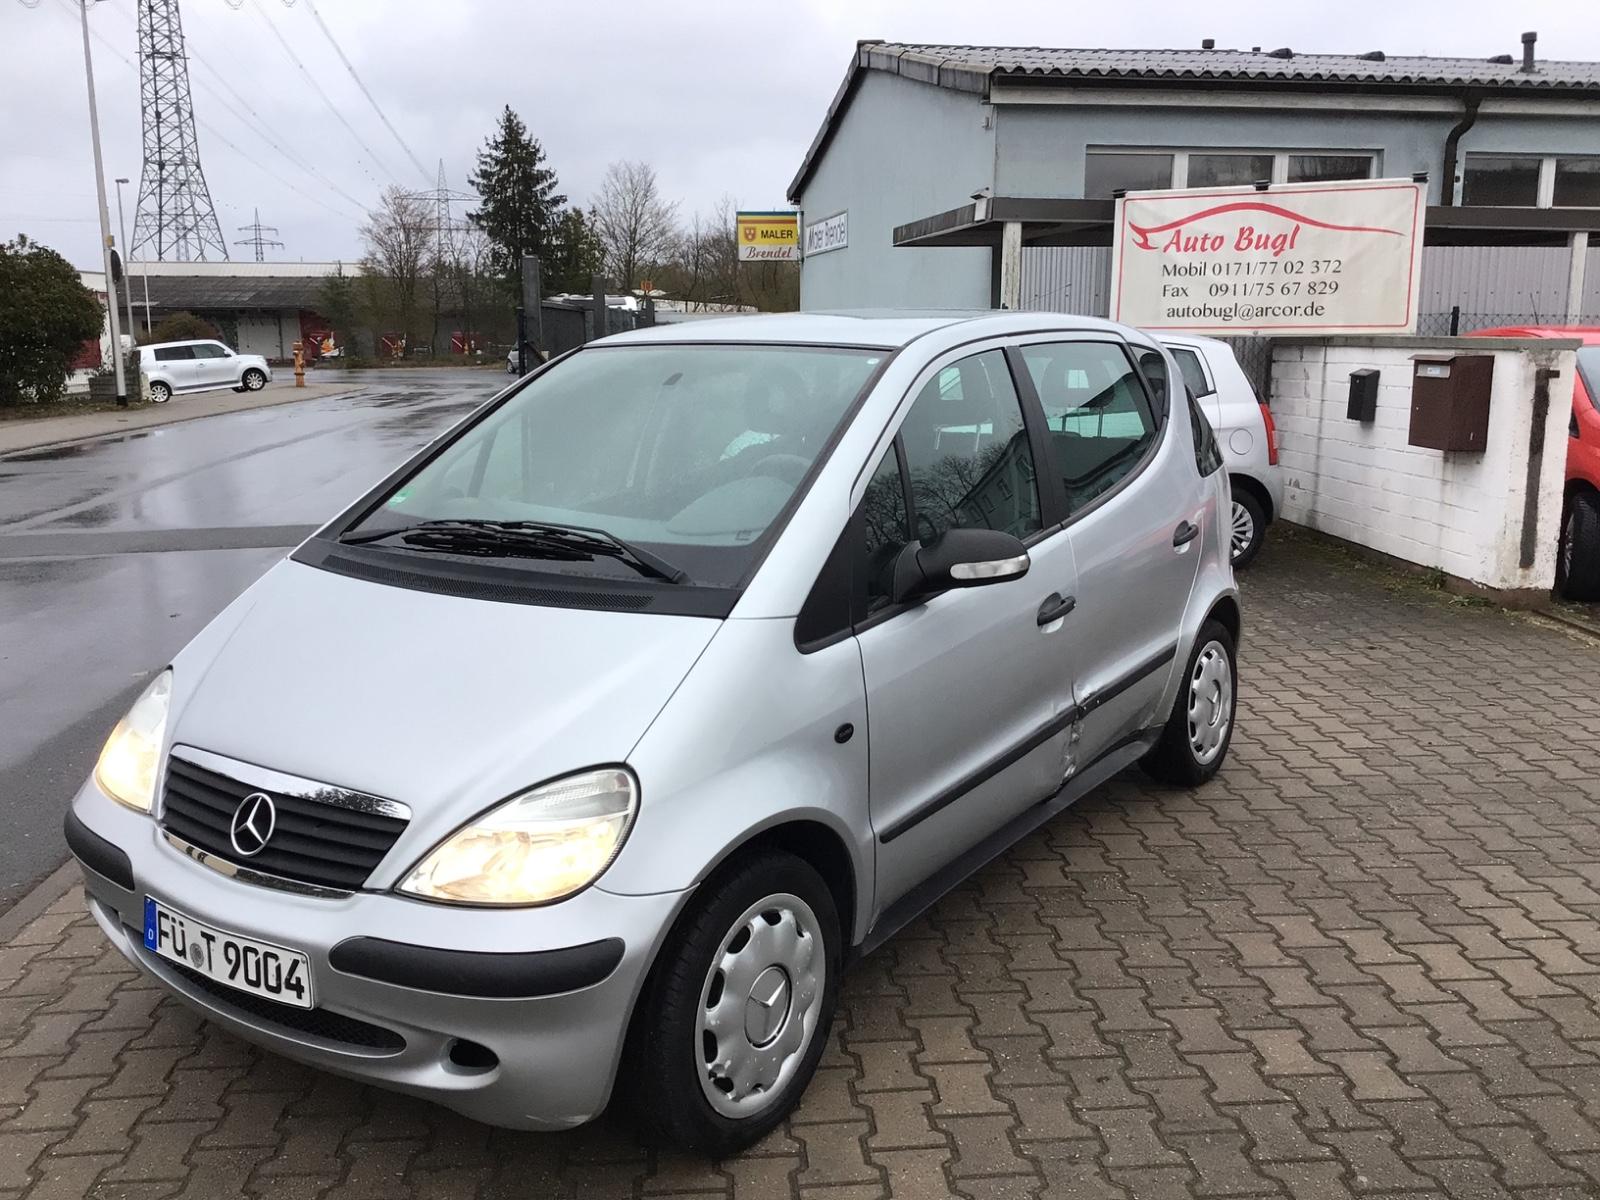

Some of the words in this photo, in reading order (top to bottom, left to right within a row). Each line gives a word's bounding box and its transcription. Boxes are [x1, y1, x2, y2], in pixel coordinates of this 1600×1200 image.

[761, 230, 793, 239] MALER
[1162, 229, 1224, 253] Auto
[1234, 224, 1301, 256] Bugl
[746, 247, 792, 258] Brendel
[1162, 262, 1207, 277] Mobil
[1212, 260, 1277, 276] 0171/77
[1284, 260, 1304, 275] 02
[1310, 259, 1342, 274] 372
[1162, 284, 1188, 298] Fax
[1209, 282, 1275, 297] 0911/75
[1280, 282, 1301, 296] 67
[1307, 281, 1339, 295] 829
[1166, 301, 1325, 321] autobugl@arcor.de
[158, 911, 187, 960] FÜ
[201, 930, 216, 973] T
[223, 941, 305, 1000] 9004
